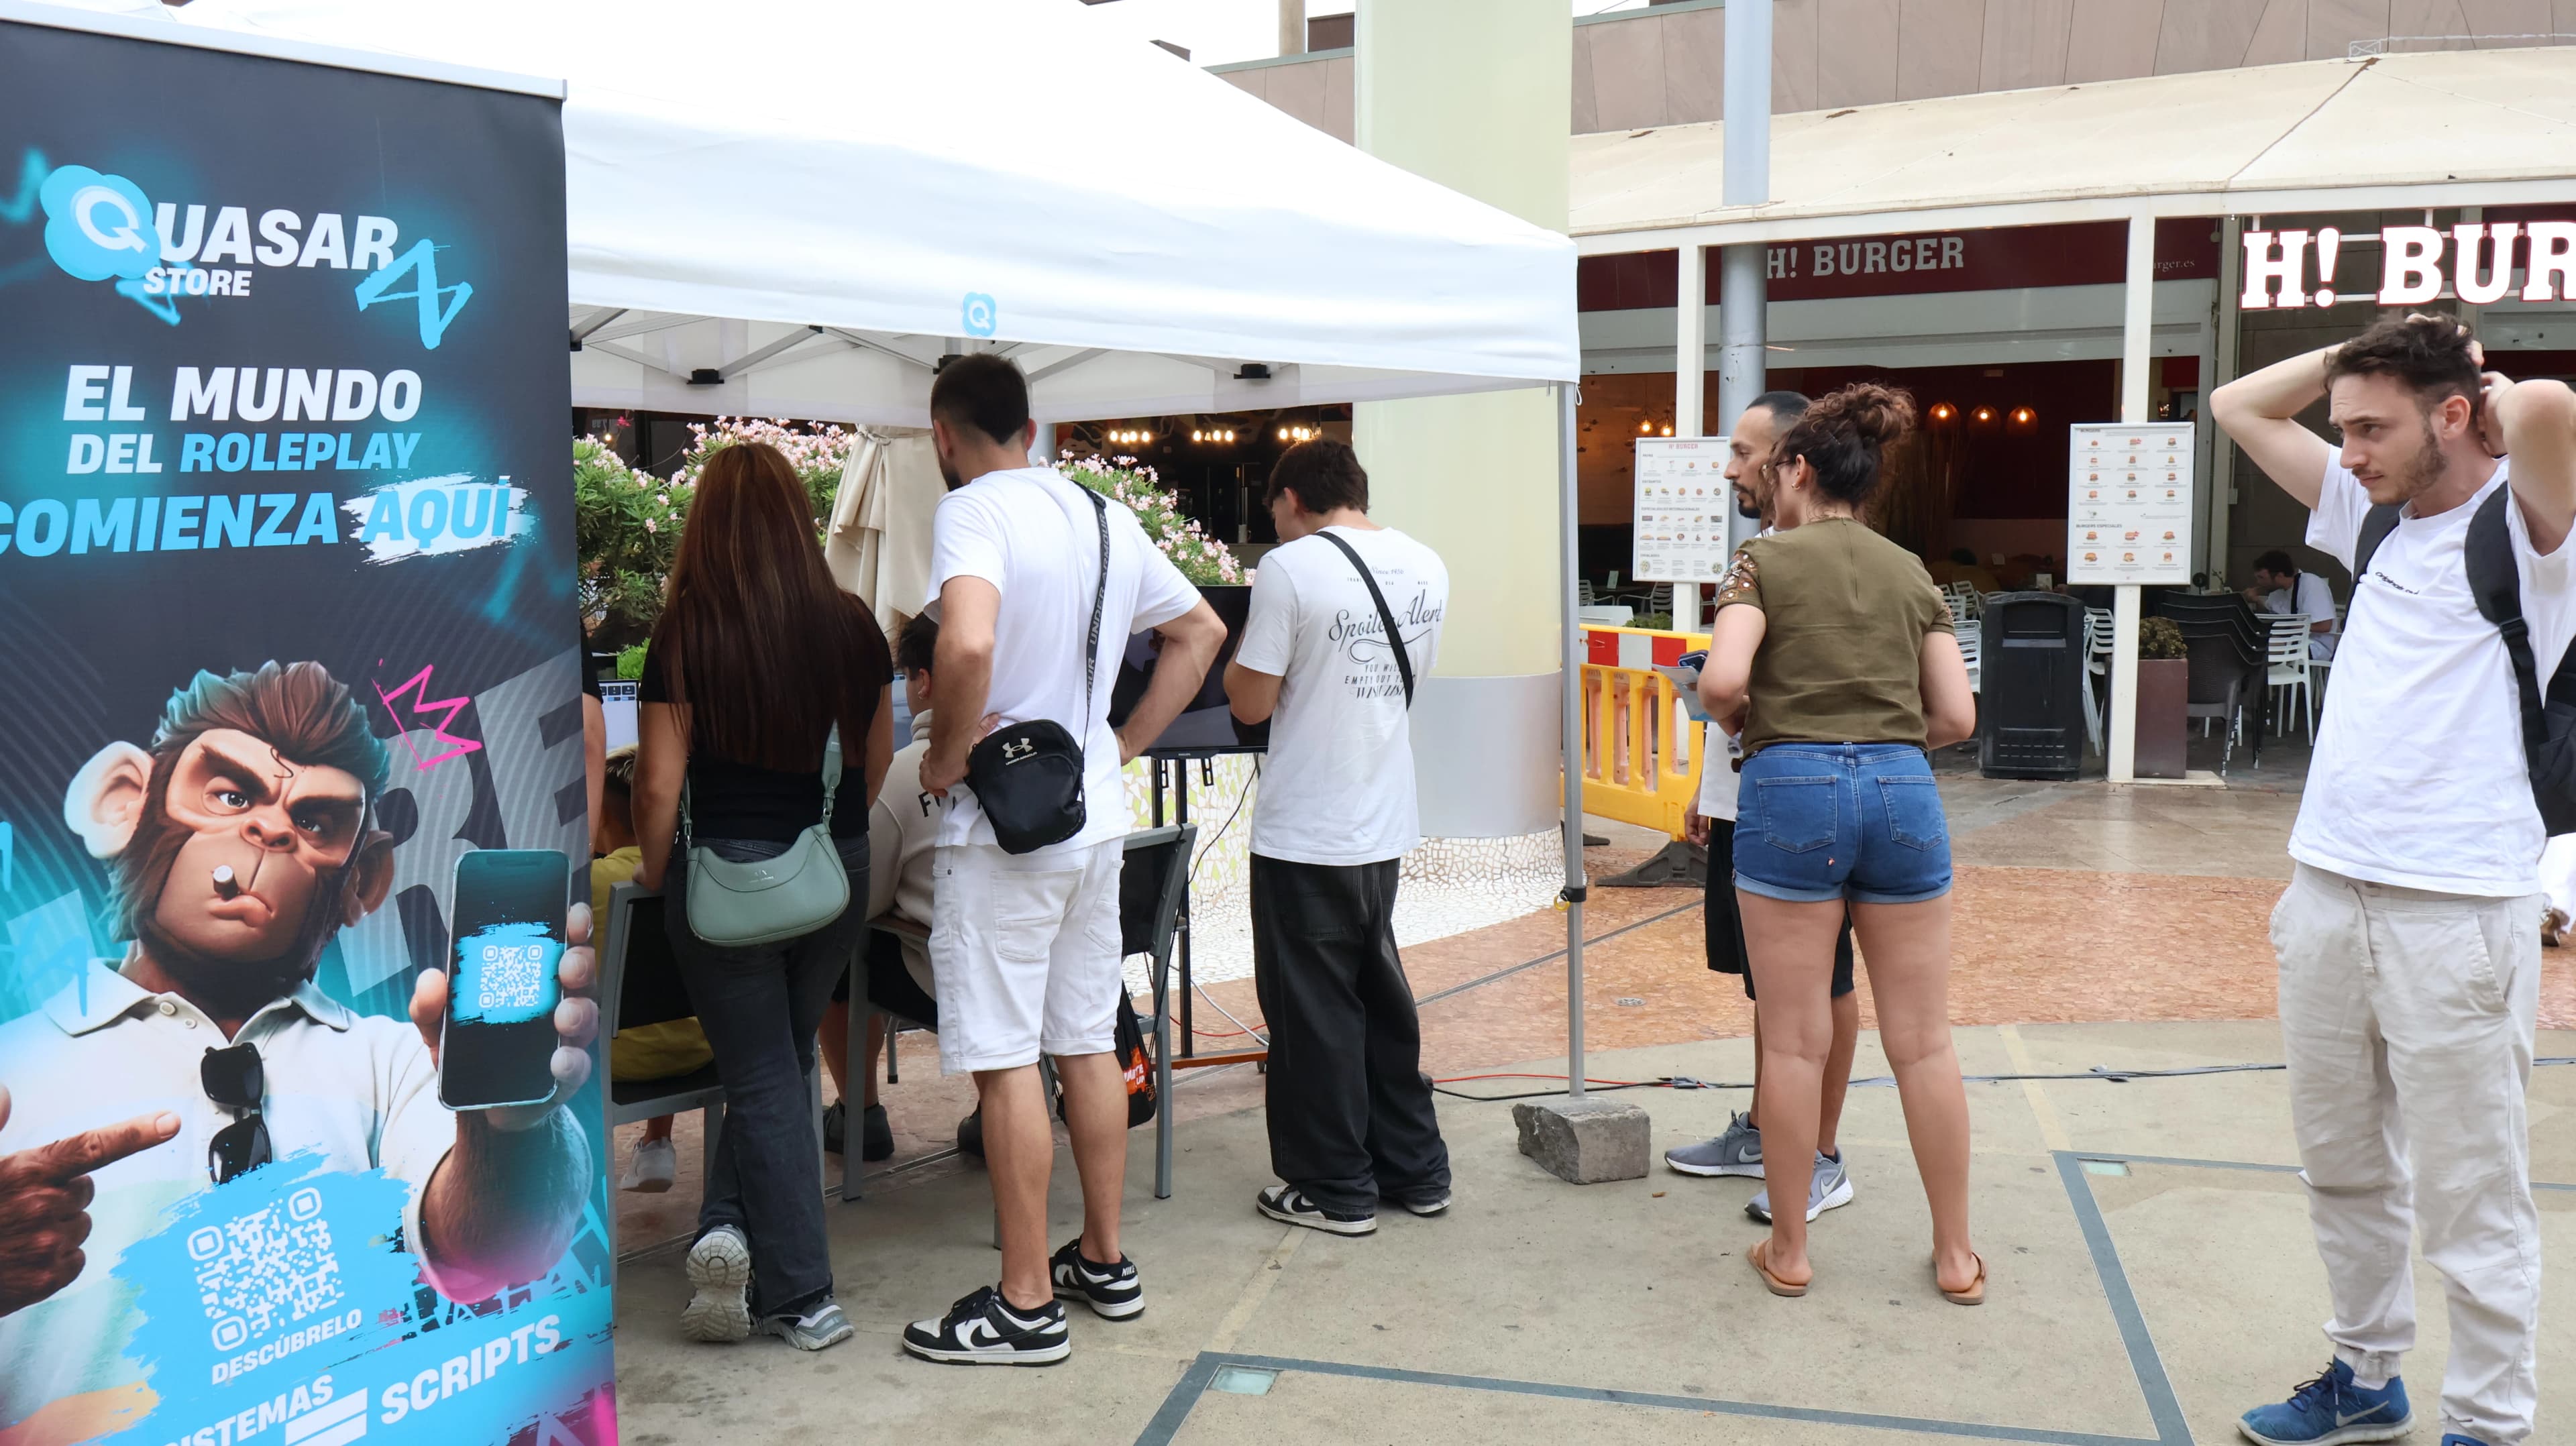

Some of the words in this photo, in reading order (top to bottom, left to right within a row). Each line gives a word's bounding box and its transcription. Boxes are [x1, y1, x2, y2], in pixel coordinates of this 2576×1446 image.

[143, 267, 253, 296] STORE
[1766, 247, 1798, 279] H!
[1813, 237, 1964, 276] BURGER
[2241, 226, 2341, 309] H!
[63, 364, 146, 421] EL
[170, 366, 423, 422] MUNDO
[66, 433, 162, 474] DEL
[179, 431, 422, 472] ROLEPLAY
[360, 476, 511, 549] AQUÍ
[1089, 586, 1106, 645] UNDER
[1329, 609, 1395, 653] Spoile
[1397, 589, 1442, 628] Alert
[1344, 675, 1373, 685] EMPTY
[1376, 675, 1391, 683] OUT
[211, 1309, 362, 1385] DESCÚBRELO
[380, 1314, 561, 1425] SCRIPTS
